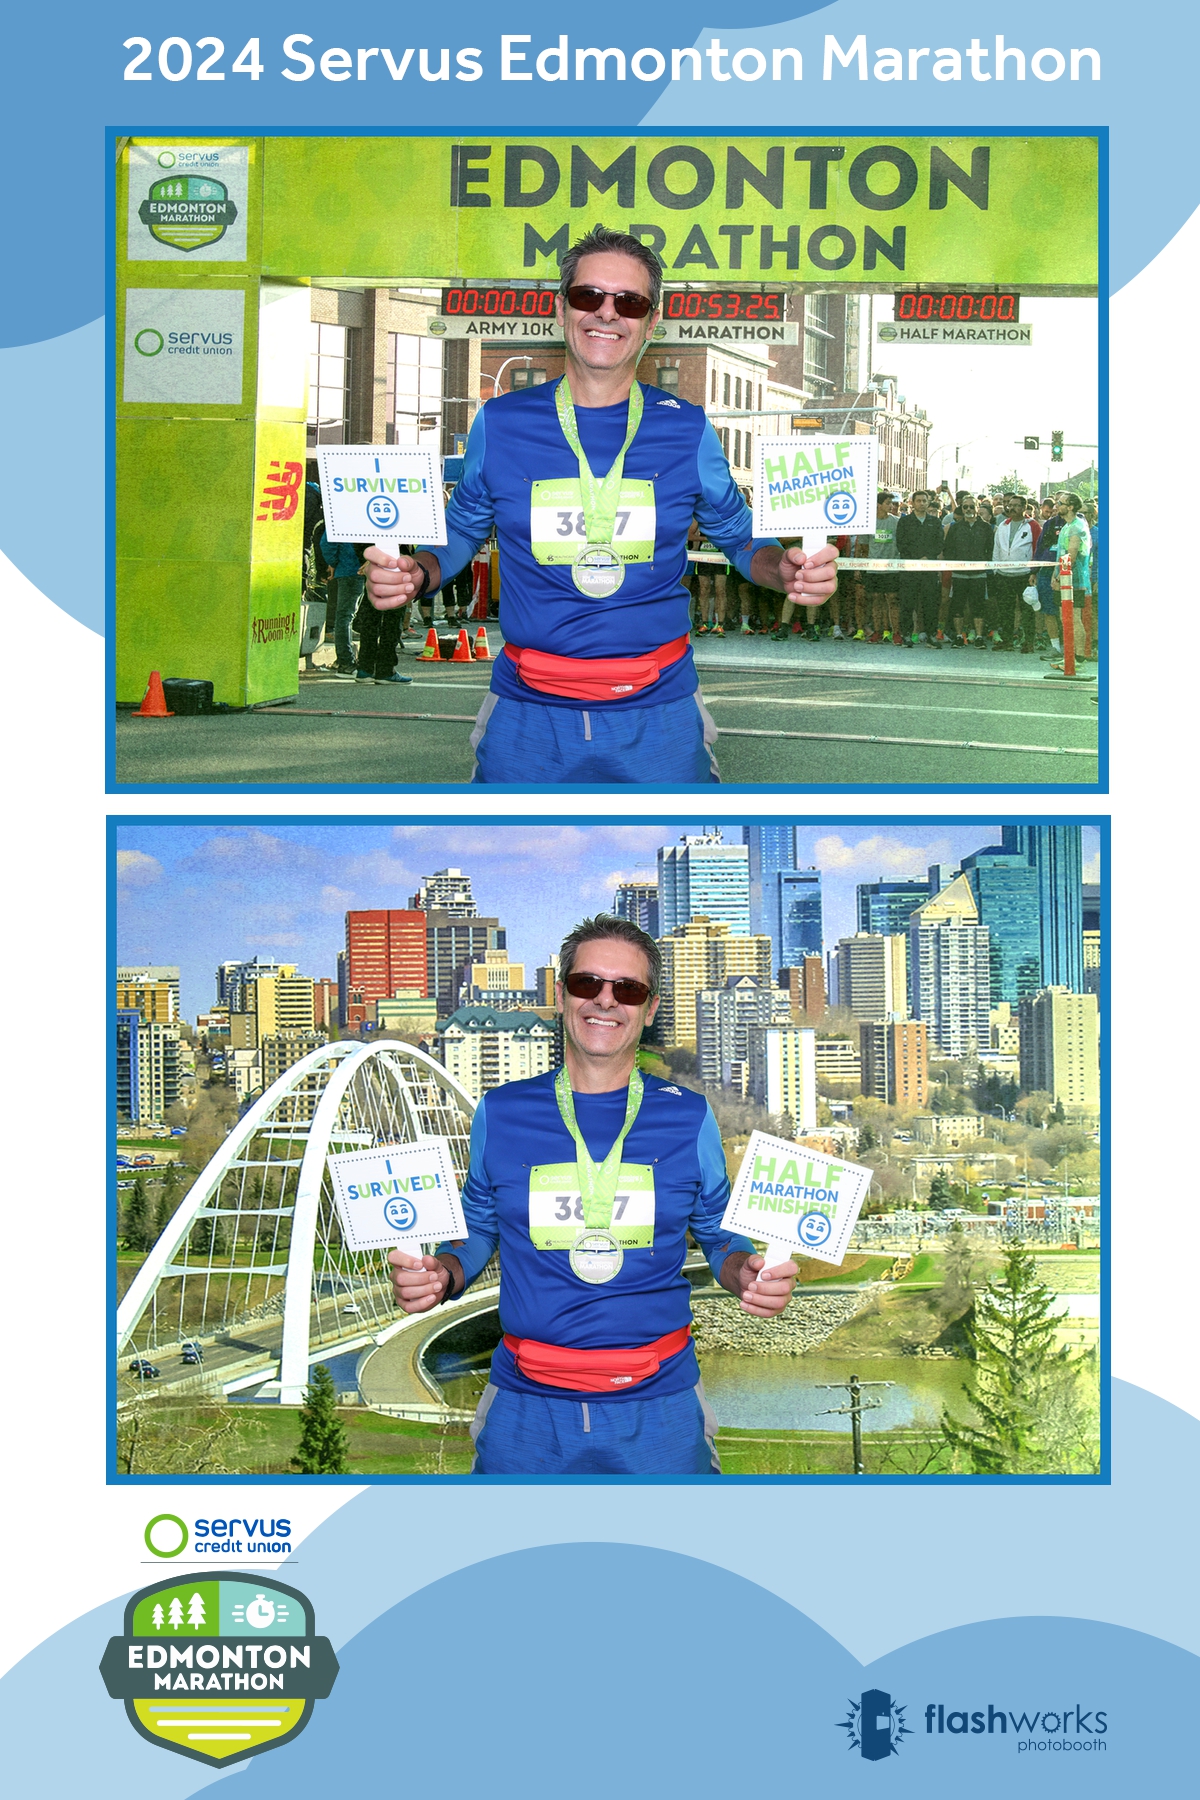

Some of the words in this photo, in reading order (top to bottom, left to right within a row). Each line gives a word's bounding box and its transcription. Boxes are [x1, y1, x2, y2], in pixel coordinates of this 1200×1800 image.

[178, 152, 219, 161] servus
[450, 144, 990, 212] EDMONTON
[149, 202, 227, 214] EDMONTON
[160, 214, 215, 222] MARATHON
[523, 222, 906, 272] MRATHON
[466, 321, 517, 335] ARMY
[522, 322, 554, 336] 10K
[679, 325, 784, 340] MARATHON
[900, 327, 939, 340] HALF
[943, 328, 1030, 341] MARATHON
[168, 332, 233, 345] servus
[168, 345, 199, 355] credit
[203, 346, 232, 355] union
[374, 458, 380, 473] I
[764, 441, 850, 483] HALF
[333, 477, 427, 493] SURVIVED!
[768, 466, 854, 496] MARATHON
[385, 1160, 392, 1175] I
[752, 1155, 843, 1189] HALF
[348, 1173, 441, 1200] SURVIVED!
[750, 1181, 839, 1203] MARATHON
